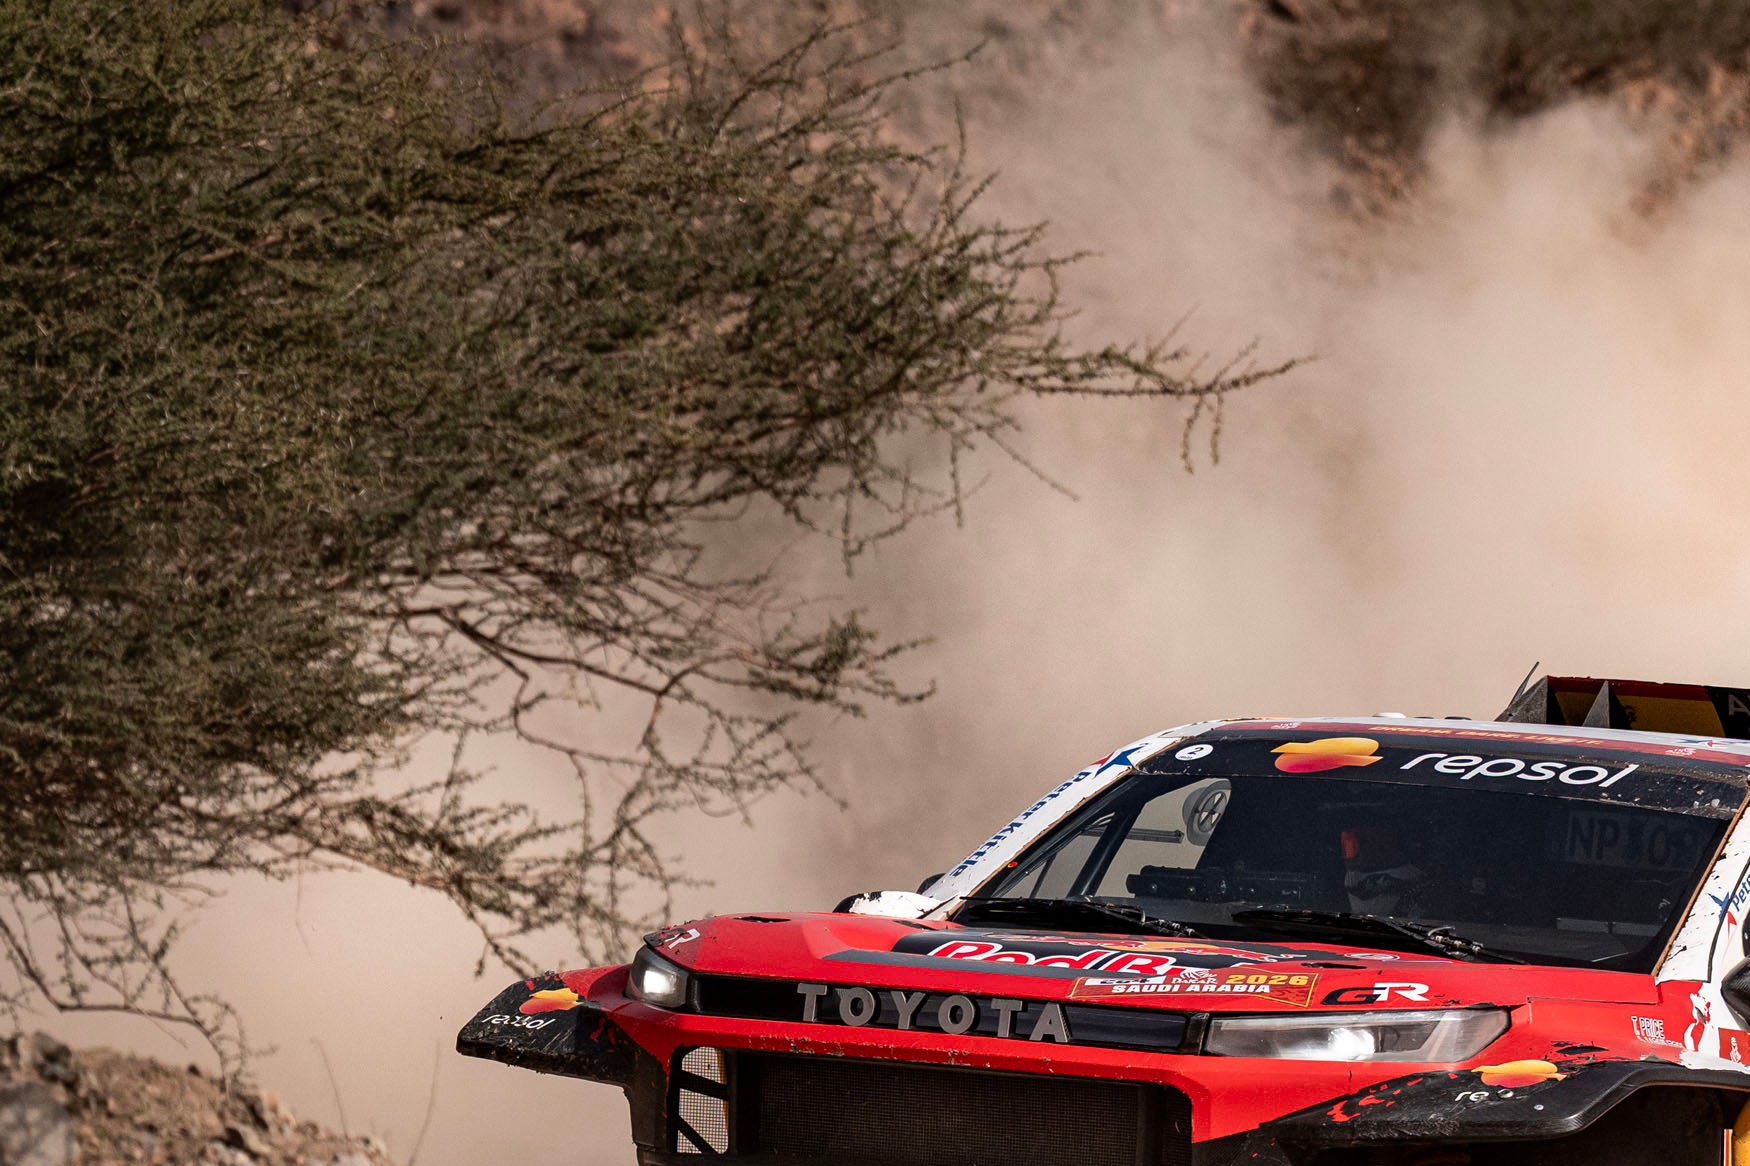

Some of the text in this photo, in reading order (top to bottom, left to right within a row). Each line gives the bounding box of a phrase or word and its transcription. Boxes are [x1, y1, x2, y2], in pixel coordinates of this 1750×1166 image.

[1400, 753, 1640, 788] repsol
[1111, 984, 1271, 994] SAUDI ARABIA
[1225, 974, 1309, 986] 2026
[1320, 982, 1430, 1006] GR
[796, 982, 1072, 1044] TOYOTA
[1639, 1017, 1666, 1039] PRICE
